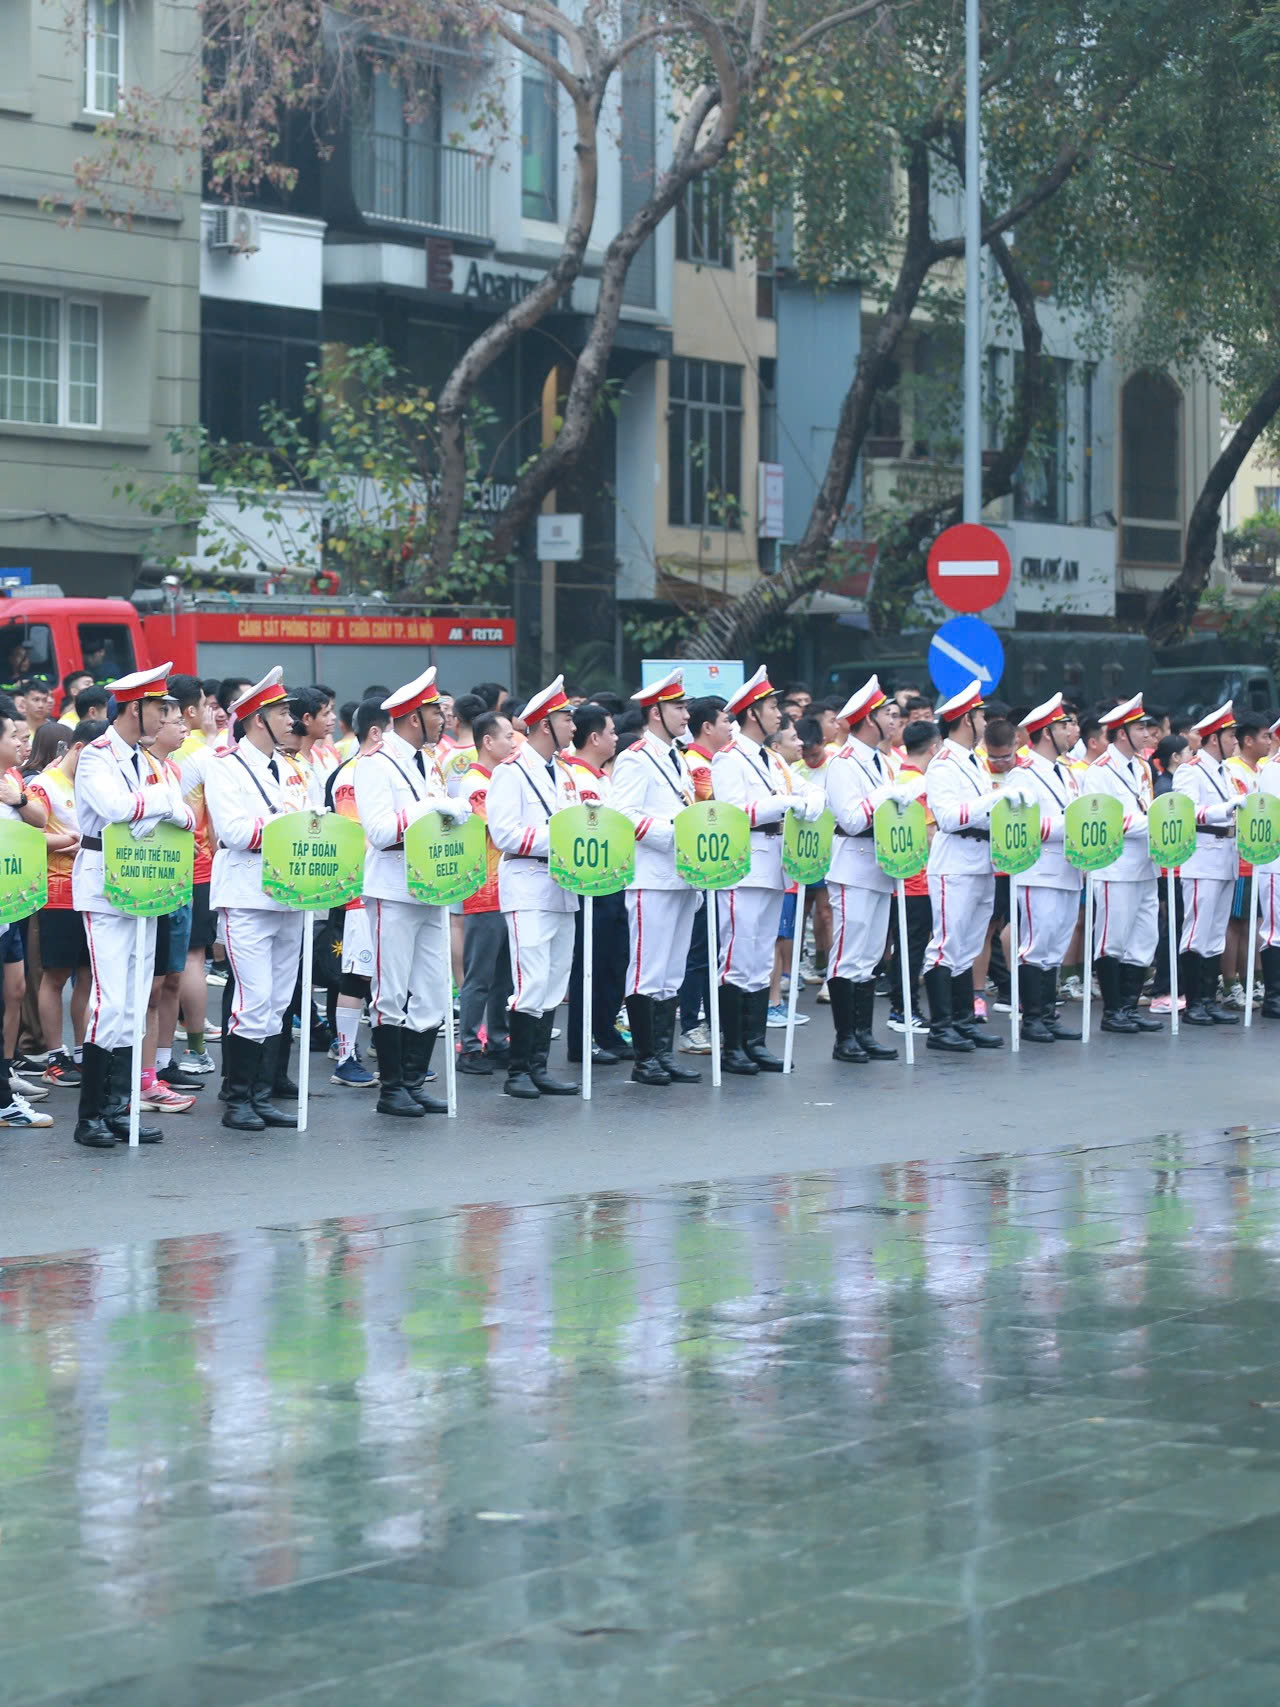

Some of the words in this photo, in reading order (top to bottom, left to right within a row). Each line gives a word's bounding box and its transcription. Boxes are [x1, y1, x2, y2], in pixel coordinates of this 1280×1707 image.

[163, 850, 181, 862] THAO
[4, 854, 22, 875] TÀI
[289, 862, 307, 876] T&T
[308, 862, 339, 876] GROUP
[436, 862, 459, 877] GELEX
[120, 865, 140, 877] CAND
[158, 866, 175, 879] NAM
